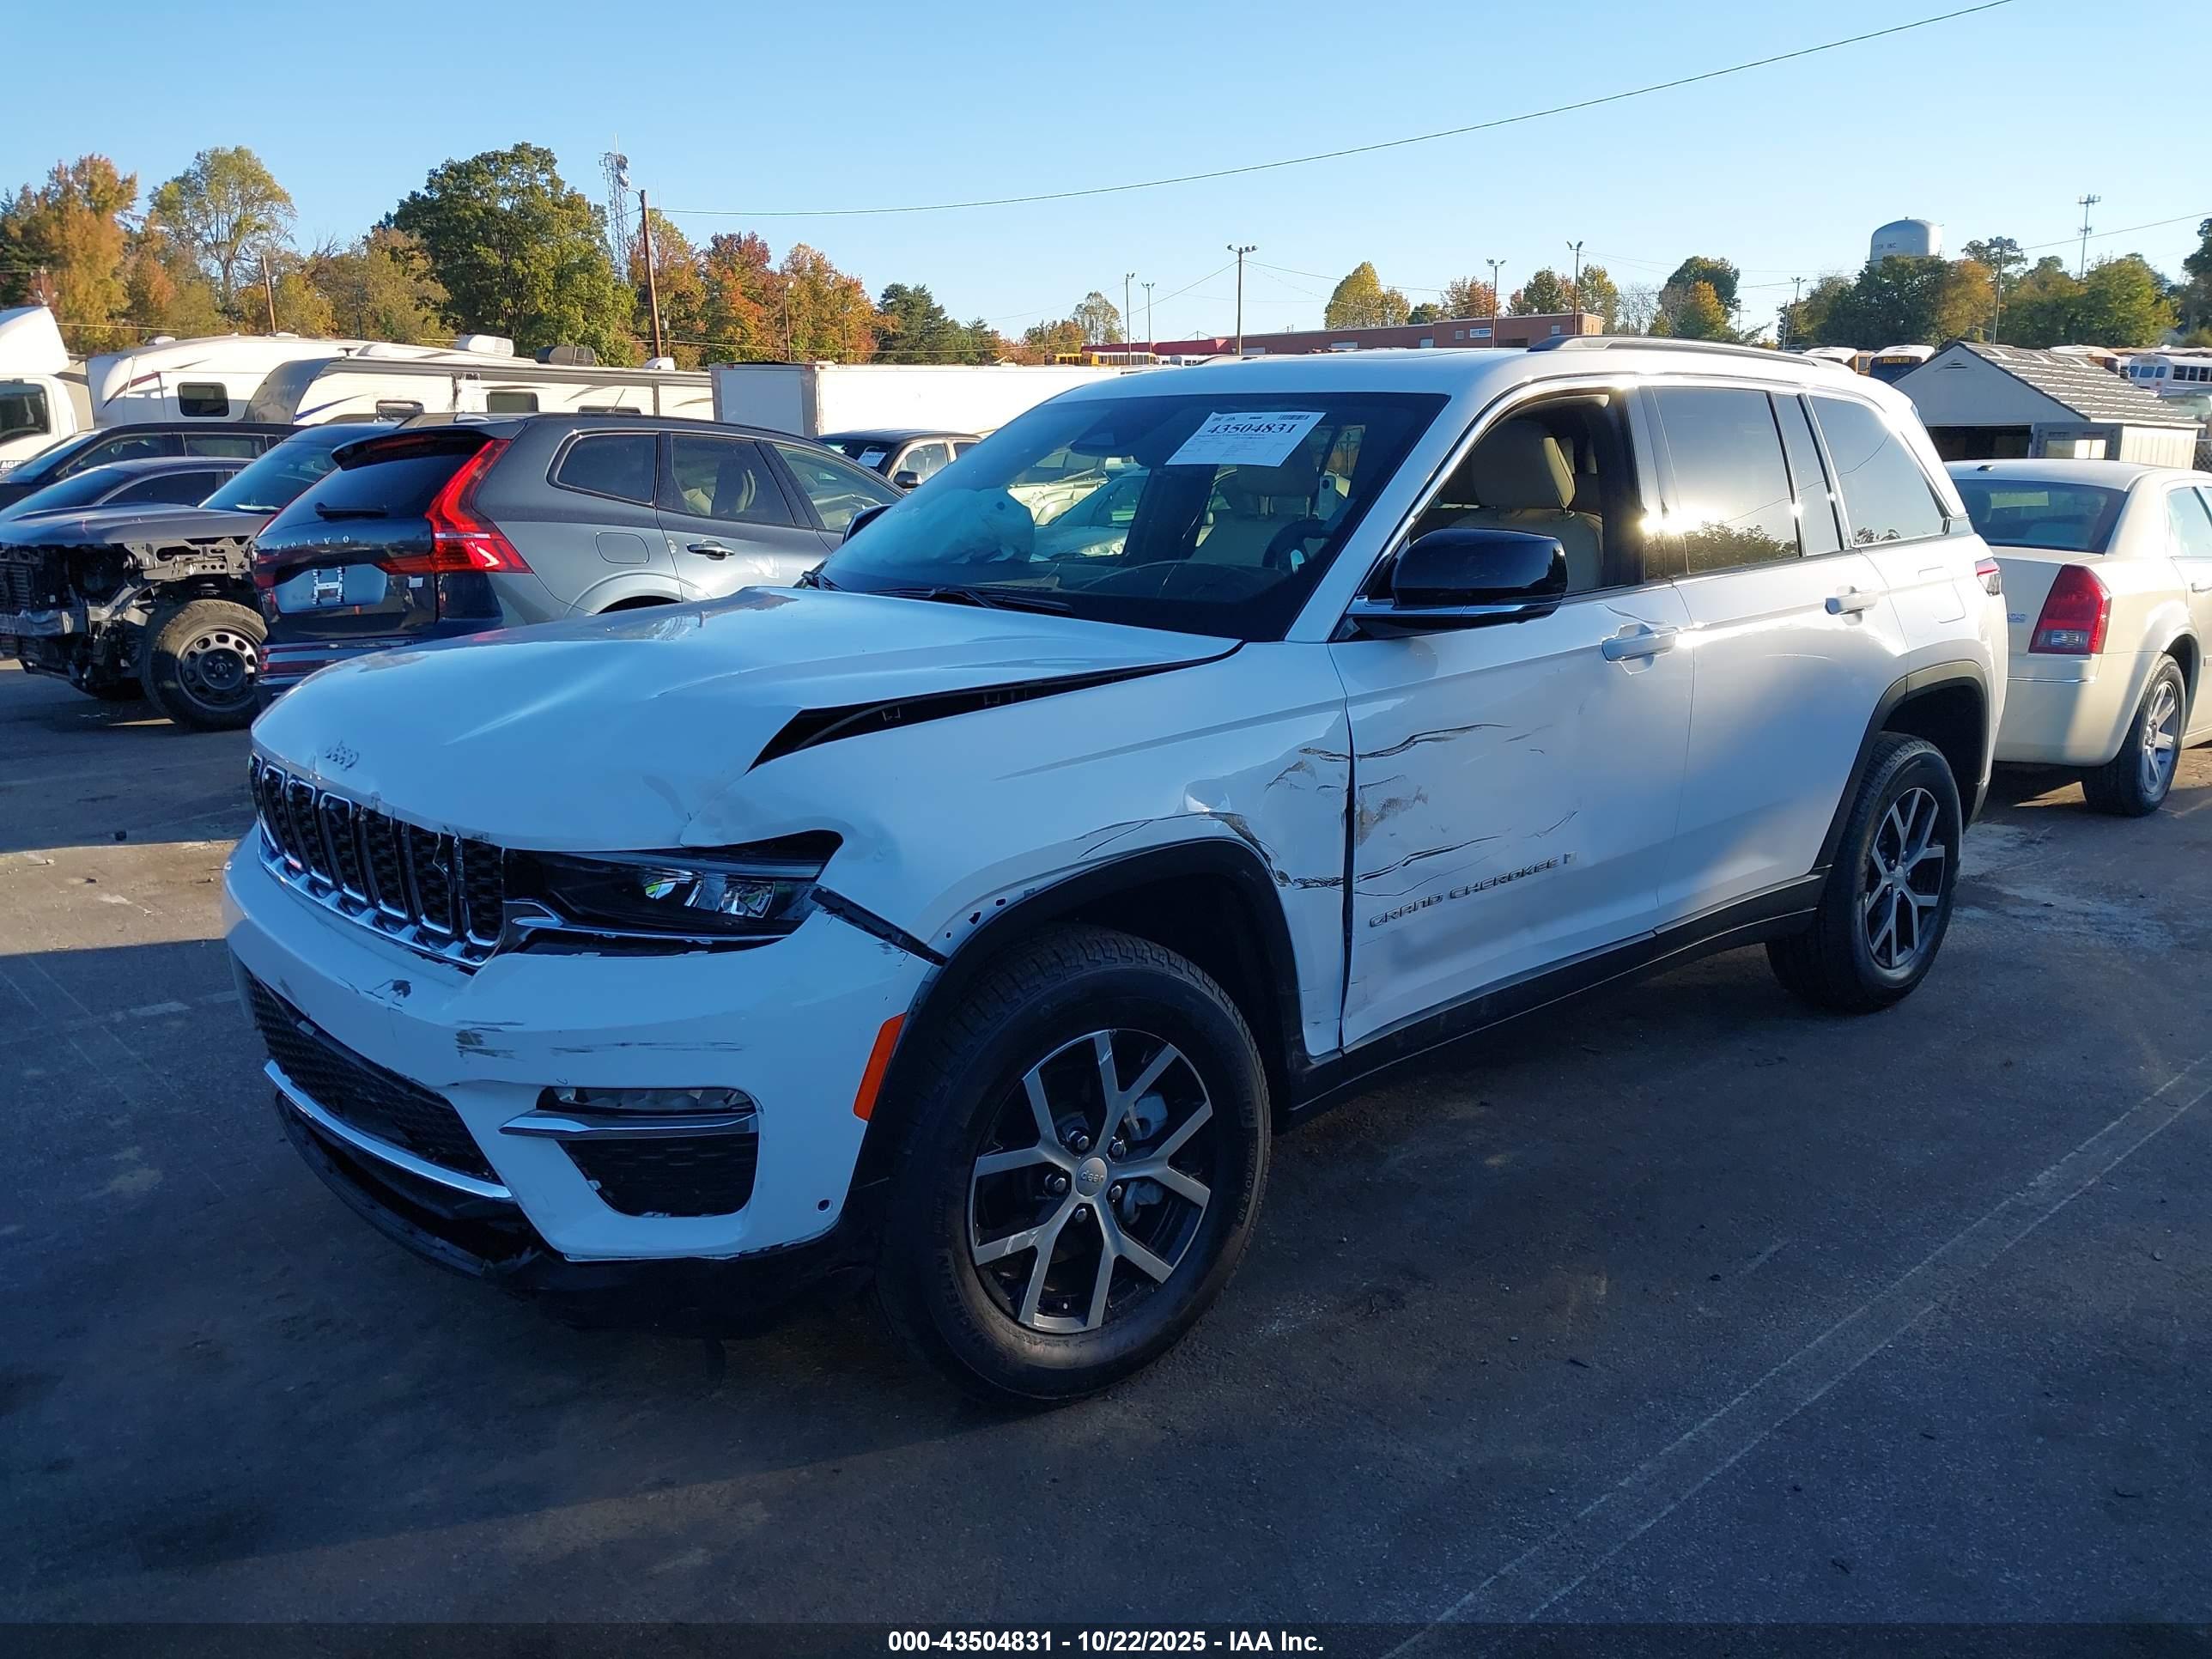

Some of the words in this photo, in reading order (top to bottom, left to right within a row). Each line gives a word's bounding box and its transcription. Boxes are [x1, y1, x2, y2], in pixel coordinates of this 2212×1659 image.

[1206, 422, 1298, 434] 43504831
[276, 535, 350, 550] VOLVO
[1369, 892, 1443, 928] GRAND
[1449, 855, 1559, 899] CHEROKEE
